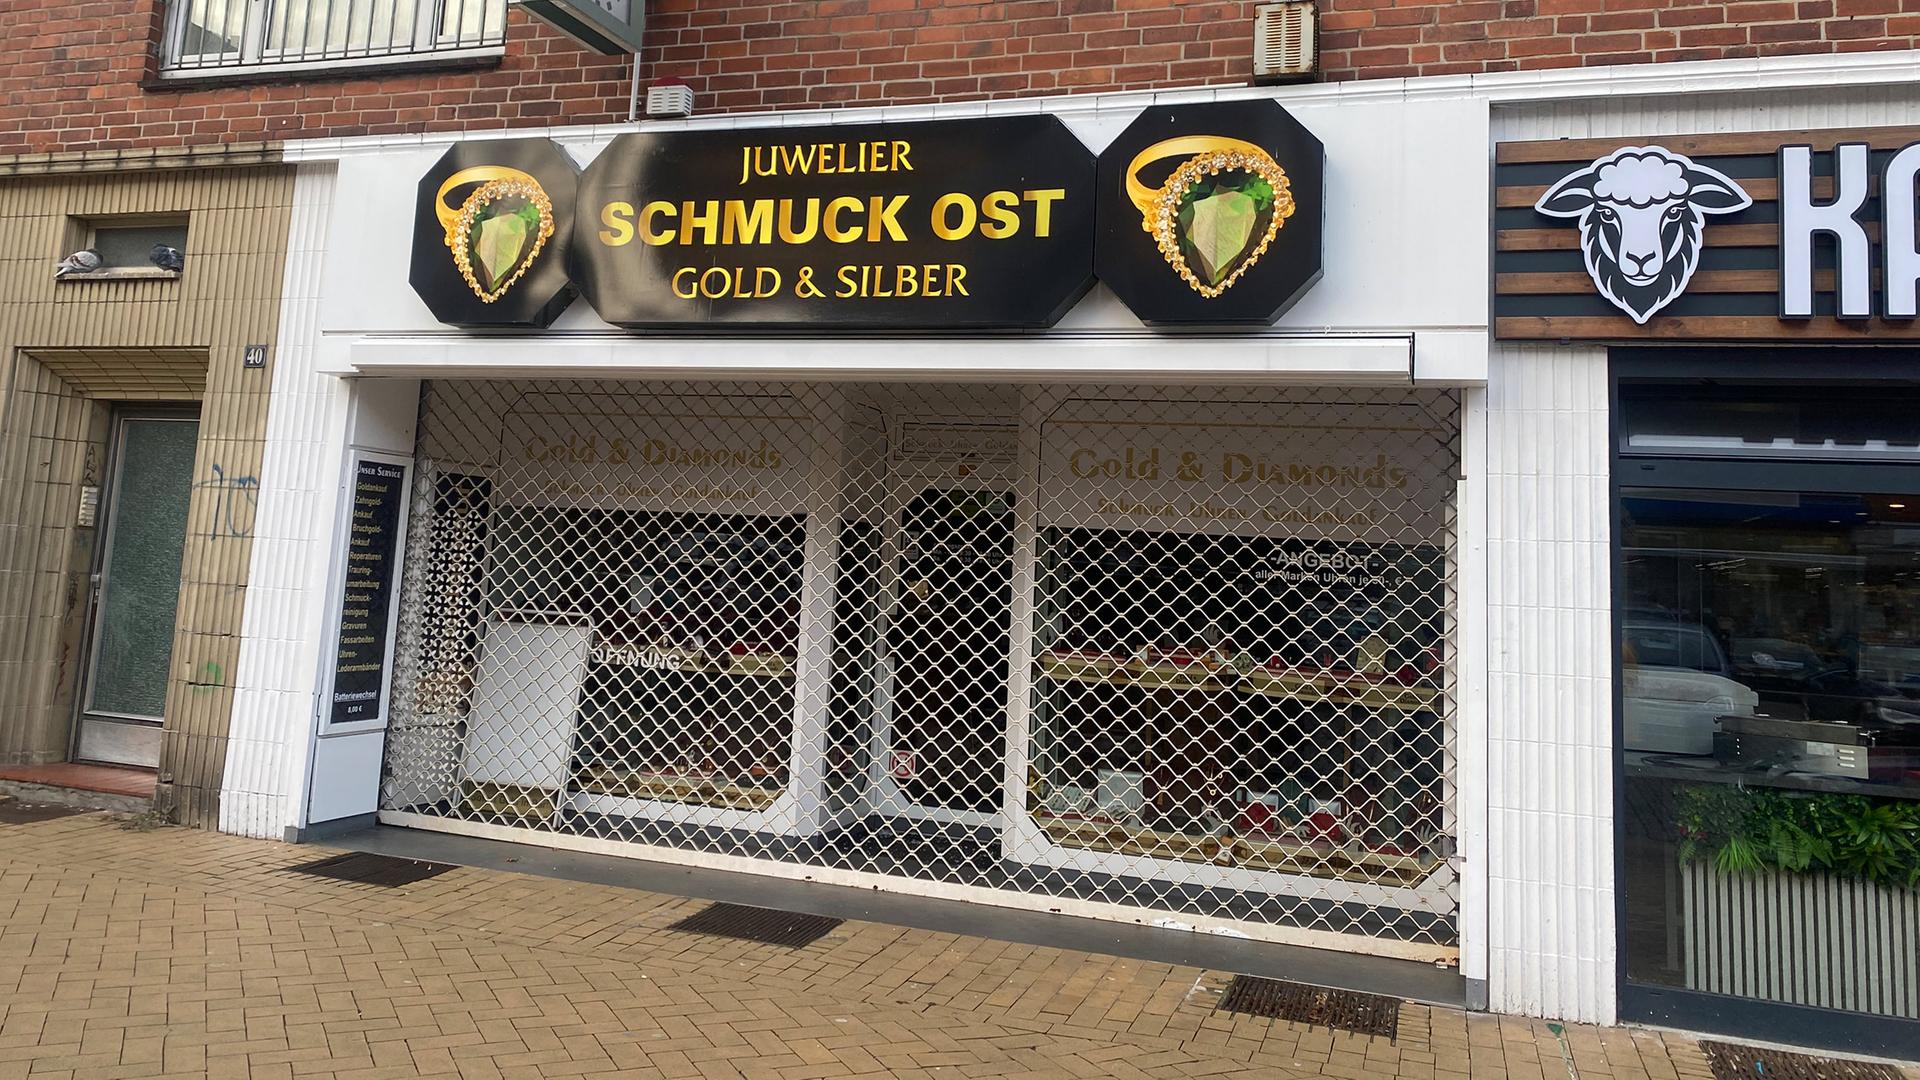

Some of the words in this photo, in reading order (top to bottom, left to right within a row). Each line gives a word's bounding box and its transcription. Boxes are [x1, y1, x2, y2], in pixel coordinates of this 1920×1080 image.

[739, 140, 914, 184] JUWELIER
[599, 195, 910, 246] SCHMUCK
[930, 188, 1066, 241] OST
[671, 265, 782, 299] GOLD
[794, 265, 827, 298] &
[835, 263, 970, 298] SILBER
[247, 348, 263, 364] 40
[524, 434, 596, 465] Gold
[607, 438, 629, 465] &
[1069, 447, 1159, 481] Gold
[1176, 451, 1202, 482] &
[357, 482, 389, 493] Goldankauf
[341, 621, 368, 631] Gravuren
[340, 635, 375, 645] Fassarbeiten
[334, 690, 377, 702] Batteriewechsel
